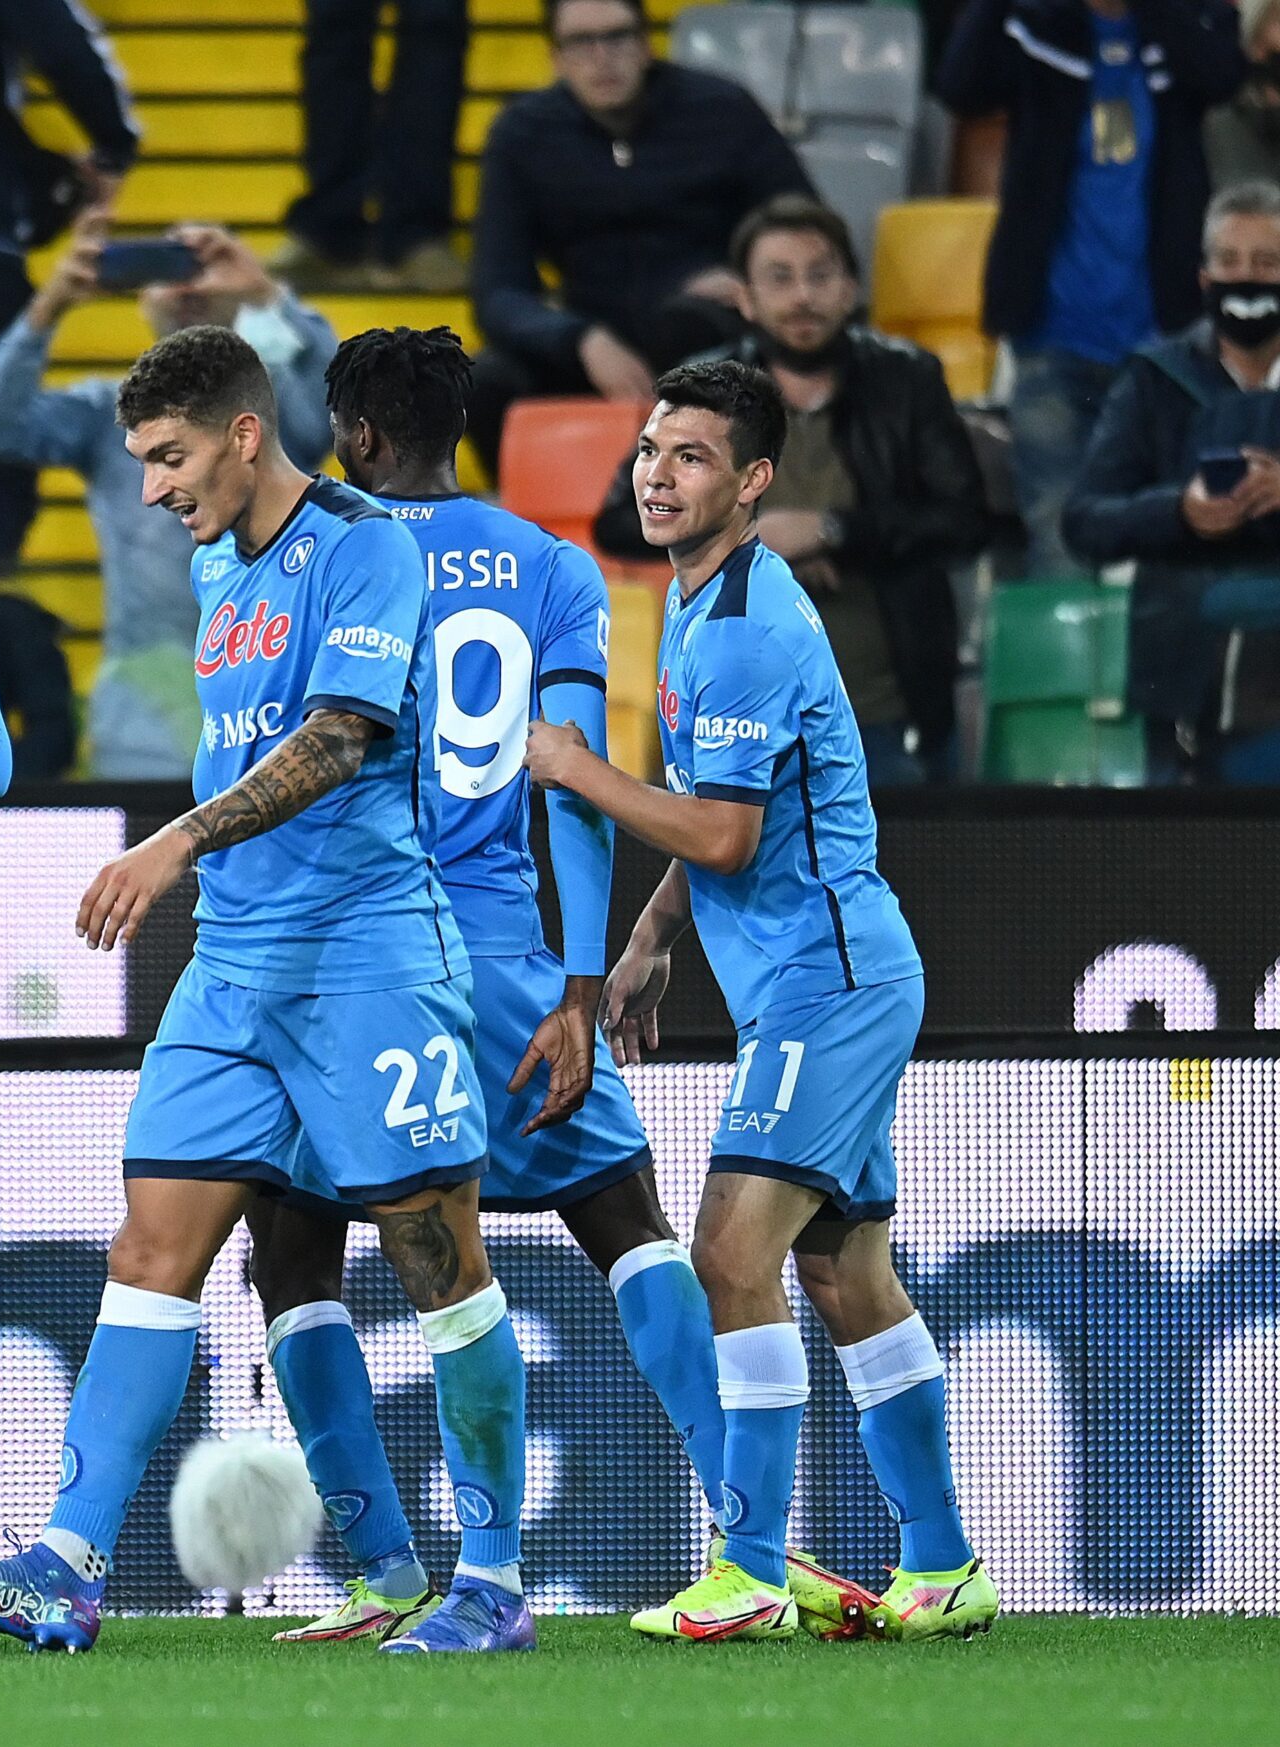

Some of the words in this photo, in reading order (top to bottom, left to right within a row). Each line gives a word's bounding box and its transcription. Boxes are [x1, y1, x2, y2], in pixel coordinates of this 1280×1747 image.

[427, 549, 518, 591] ISSA
[195, 601, 291, 678] Lete
[326, 623, 412, 663] amazon
[221, 702, 284, 749] MSC
[373, 1035, 470, 1129] 22
[729, 1040, 805, 1113] 11
[409, 1116, 459, 1148] EA7
[729, 1110, 782, 1135] EA7
